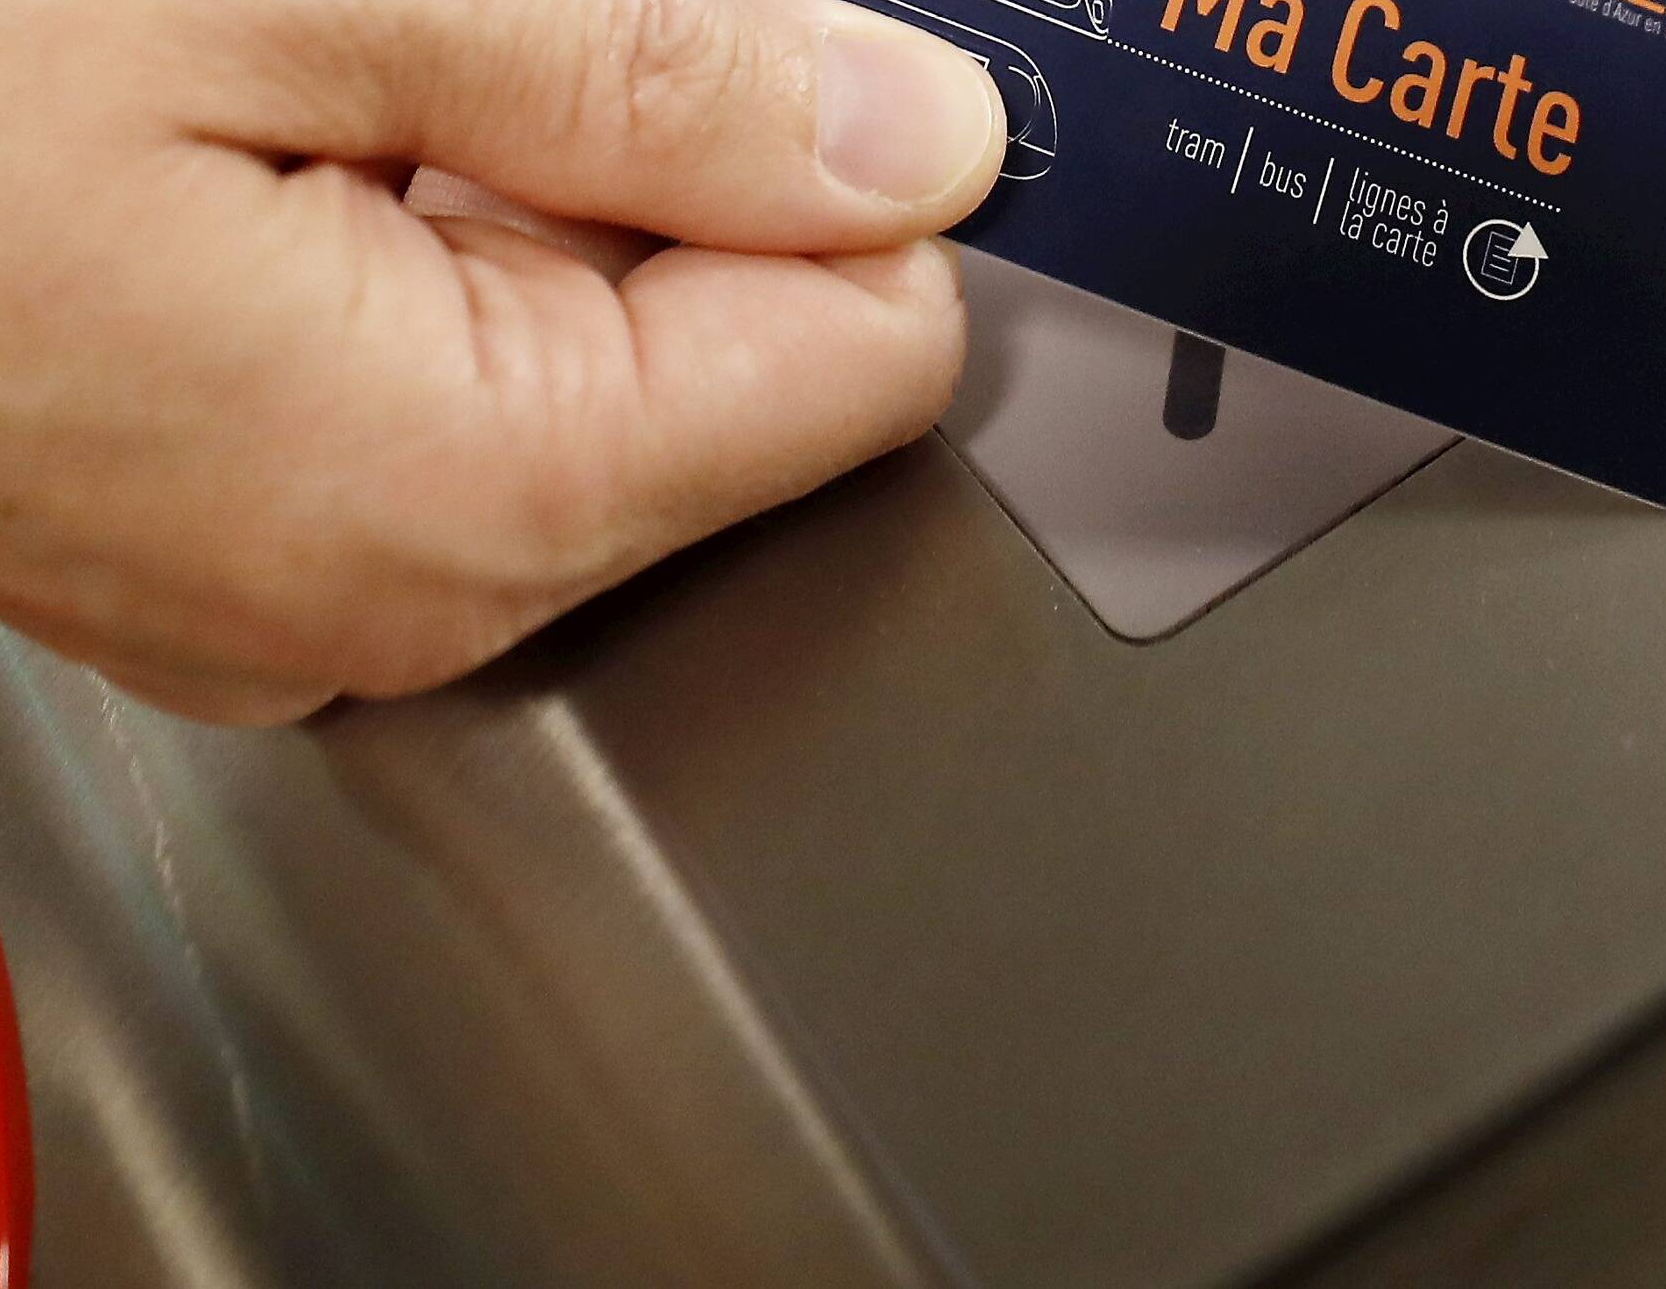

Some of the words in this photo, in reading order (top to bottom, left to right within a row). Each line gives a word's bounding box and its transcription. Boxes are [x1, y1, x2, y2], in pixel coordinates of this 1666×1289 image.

[1602, 0, 1641, 26] d'Azur
[1644, 18, 1661, 35] en
[1165, 118, 1226, 169] tram
[1259, 151, 1307, 199] bus
[1348, 167, 1426, 226] lignes
[1433, 199, 1450, 235] à
[1339, 200, 1364, 241] la
[1371, 222, 1437, 267] carte
